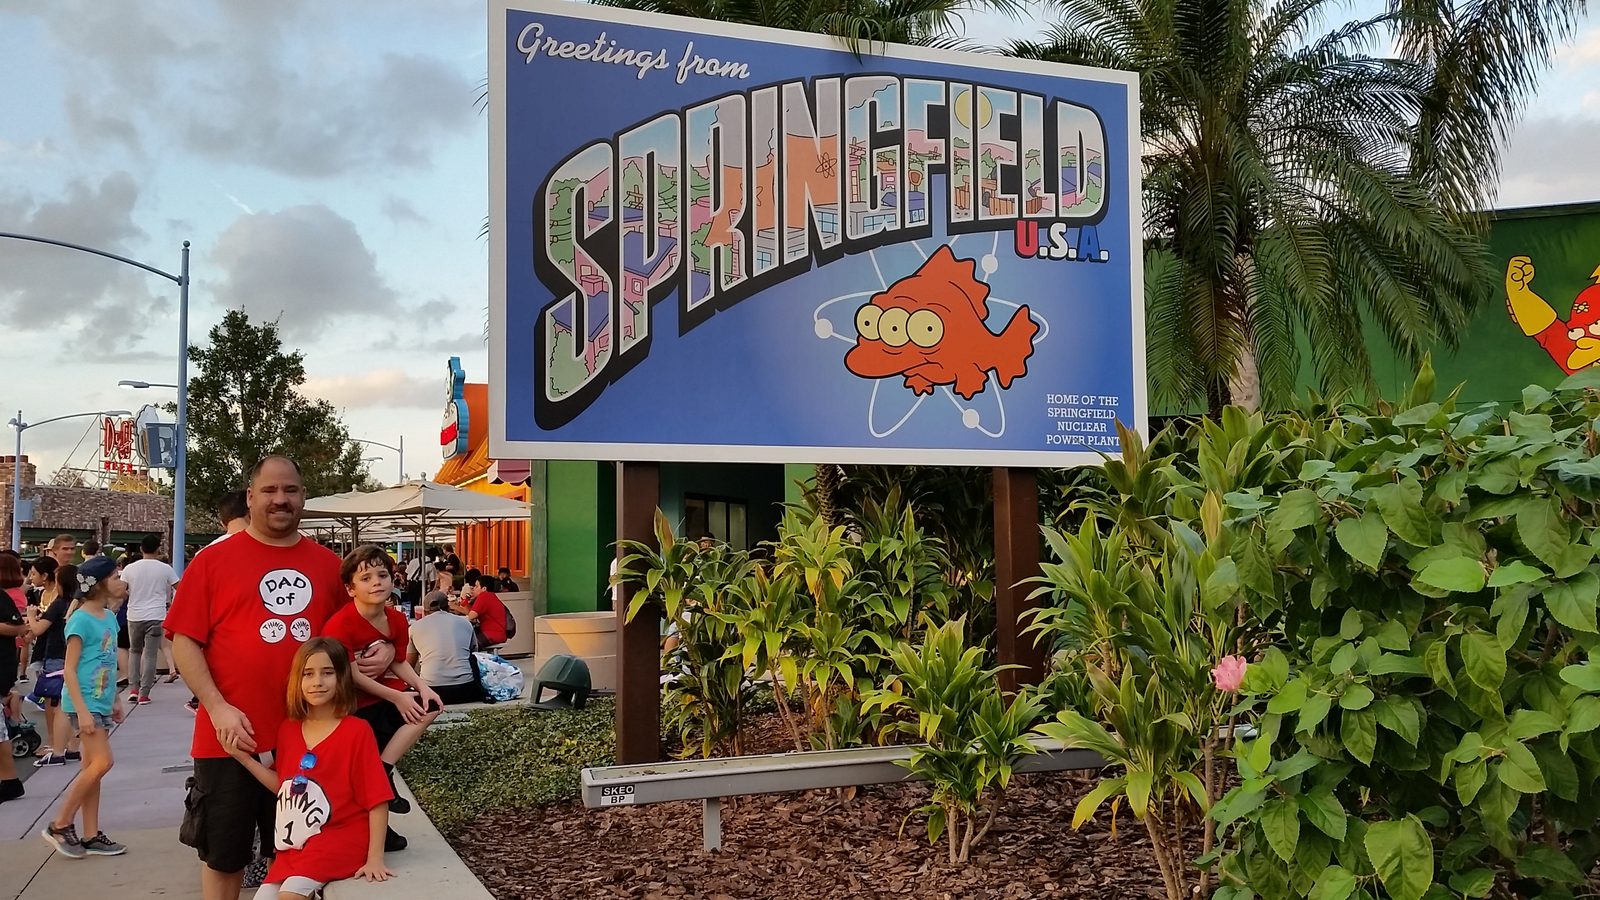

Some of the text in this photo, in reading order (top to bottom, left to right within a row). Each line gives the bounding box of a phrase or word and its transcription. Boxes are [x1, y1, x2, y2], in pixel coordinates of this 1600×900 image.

[516, 22, 750, 85] Greetings from
[1015, 219, 1110, 262] U.S.A.
[537, 73, 1108, 425] SPRINGFIELD
[1046, 393, 1119, 407] HOME OF THE
[1047, 407, 1116, 420] SPRINGFIELD
[1057, 421, 1108, 433] NUCLEAR
[1046, 434, 1120, 447] POWER PLANT
[265, 577, 306, 593] DAD
[276, 593, 295, 605] of
[262, 621, 283, 631] THING
[291, 621, 310, 631] THING
[603, 785, 634, 795] SKEO
[278, 789, 323, 828] THING
[282, 820, 294, 846] 1
